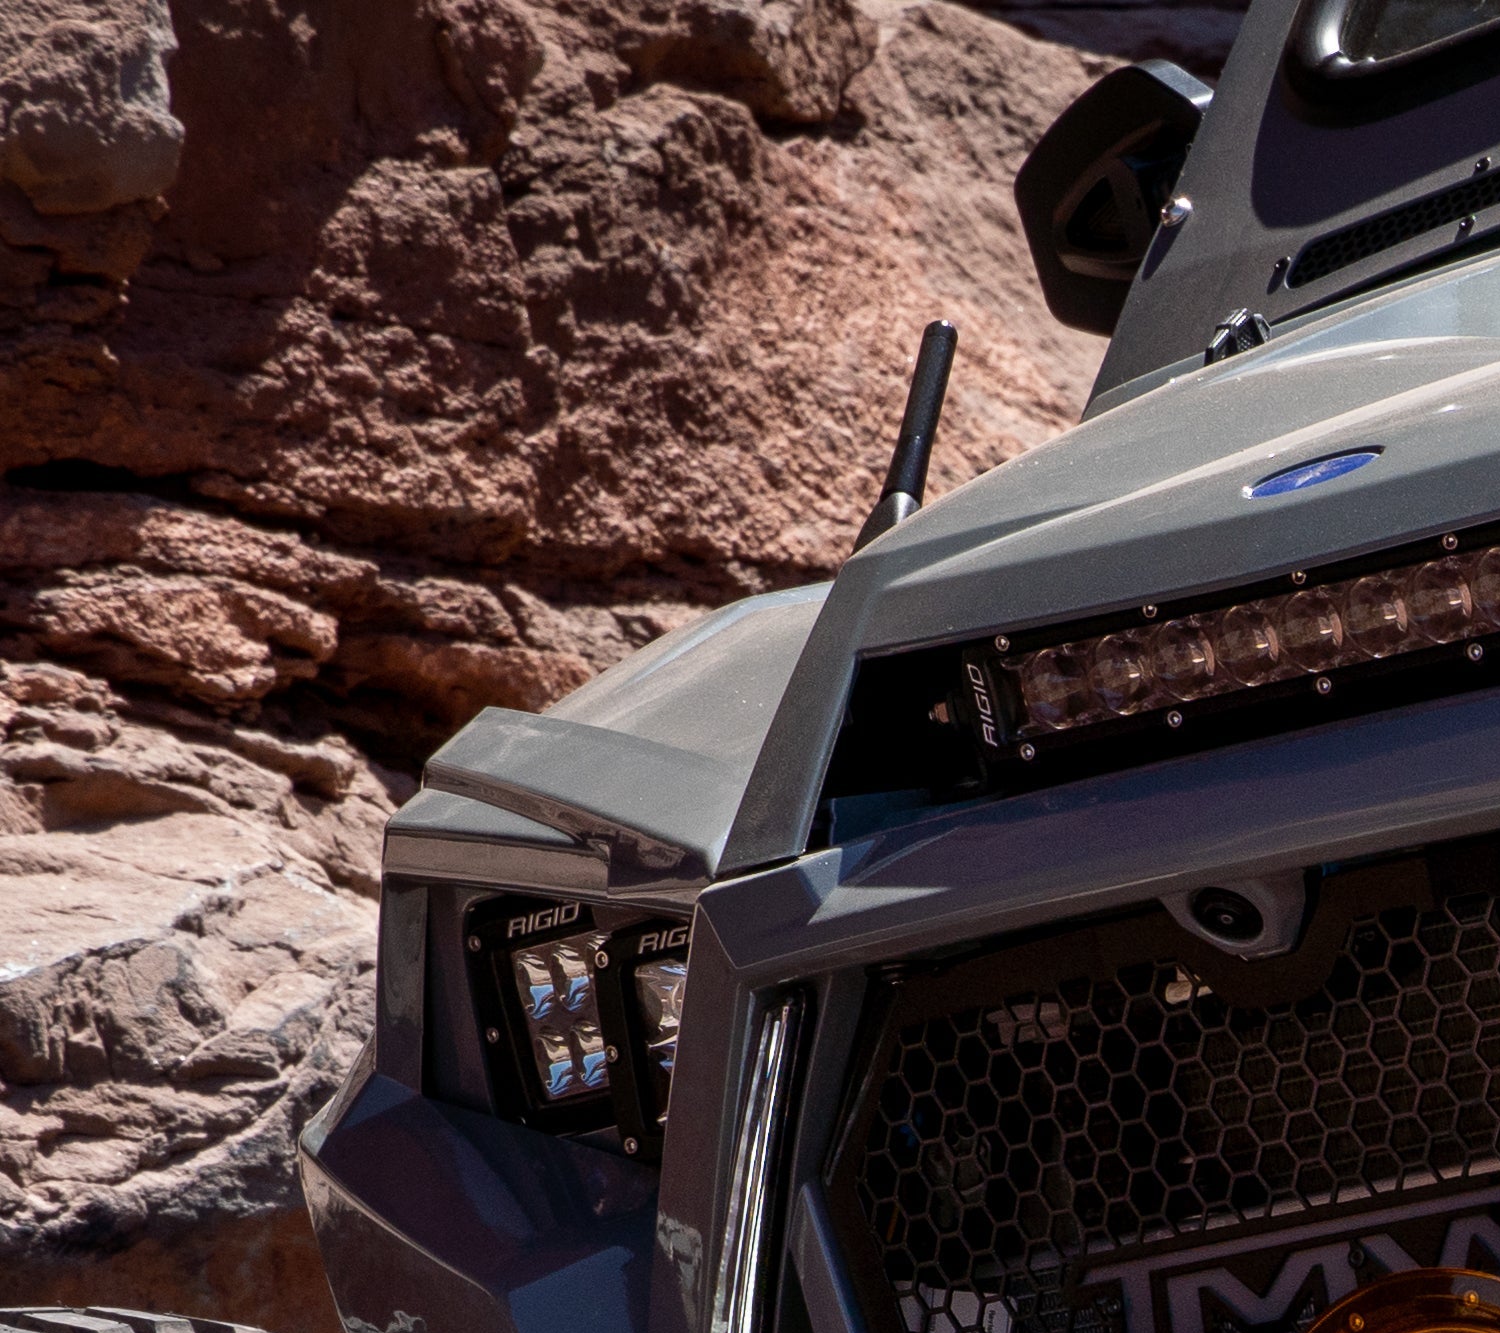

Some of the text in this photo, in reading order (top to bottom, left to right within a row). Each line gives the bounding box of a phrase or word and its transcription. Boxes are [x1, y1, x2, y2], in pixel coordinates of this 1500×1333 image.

[966, 663, 998, 748] RIGID
[507, 901, 581, 939] RIGID
[637, 925, 691, 955] RIG
